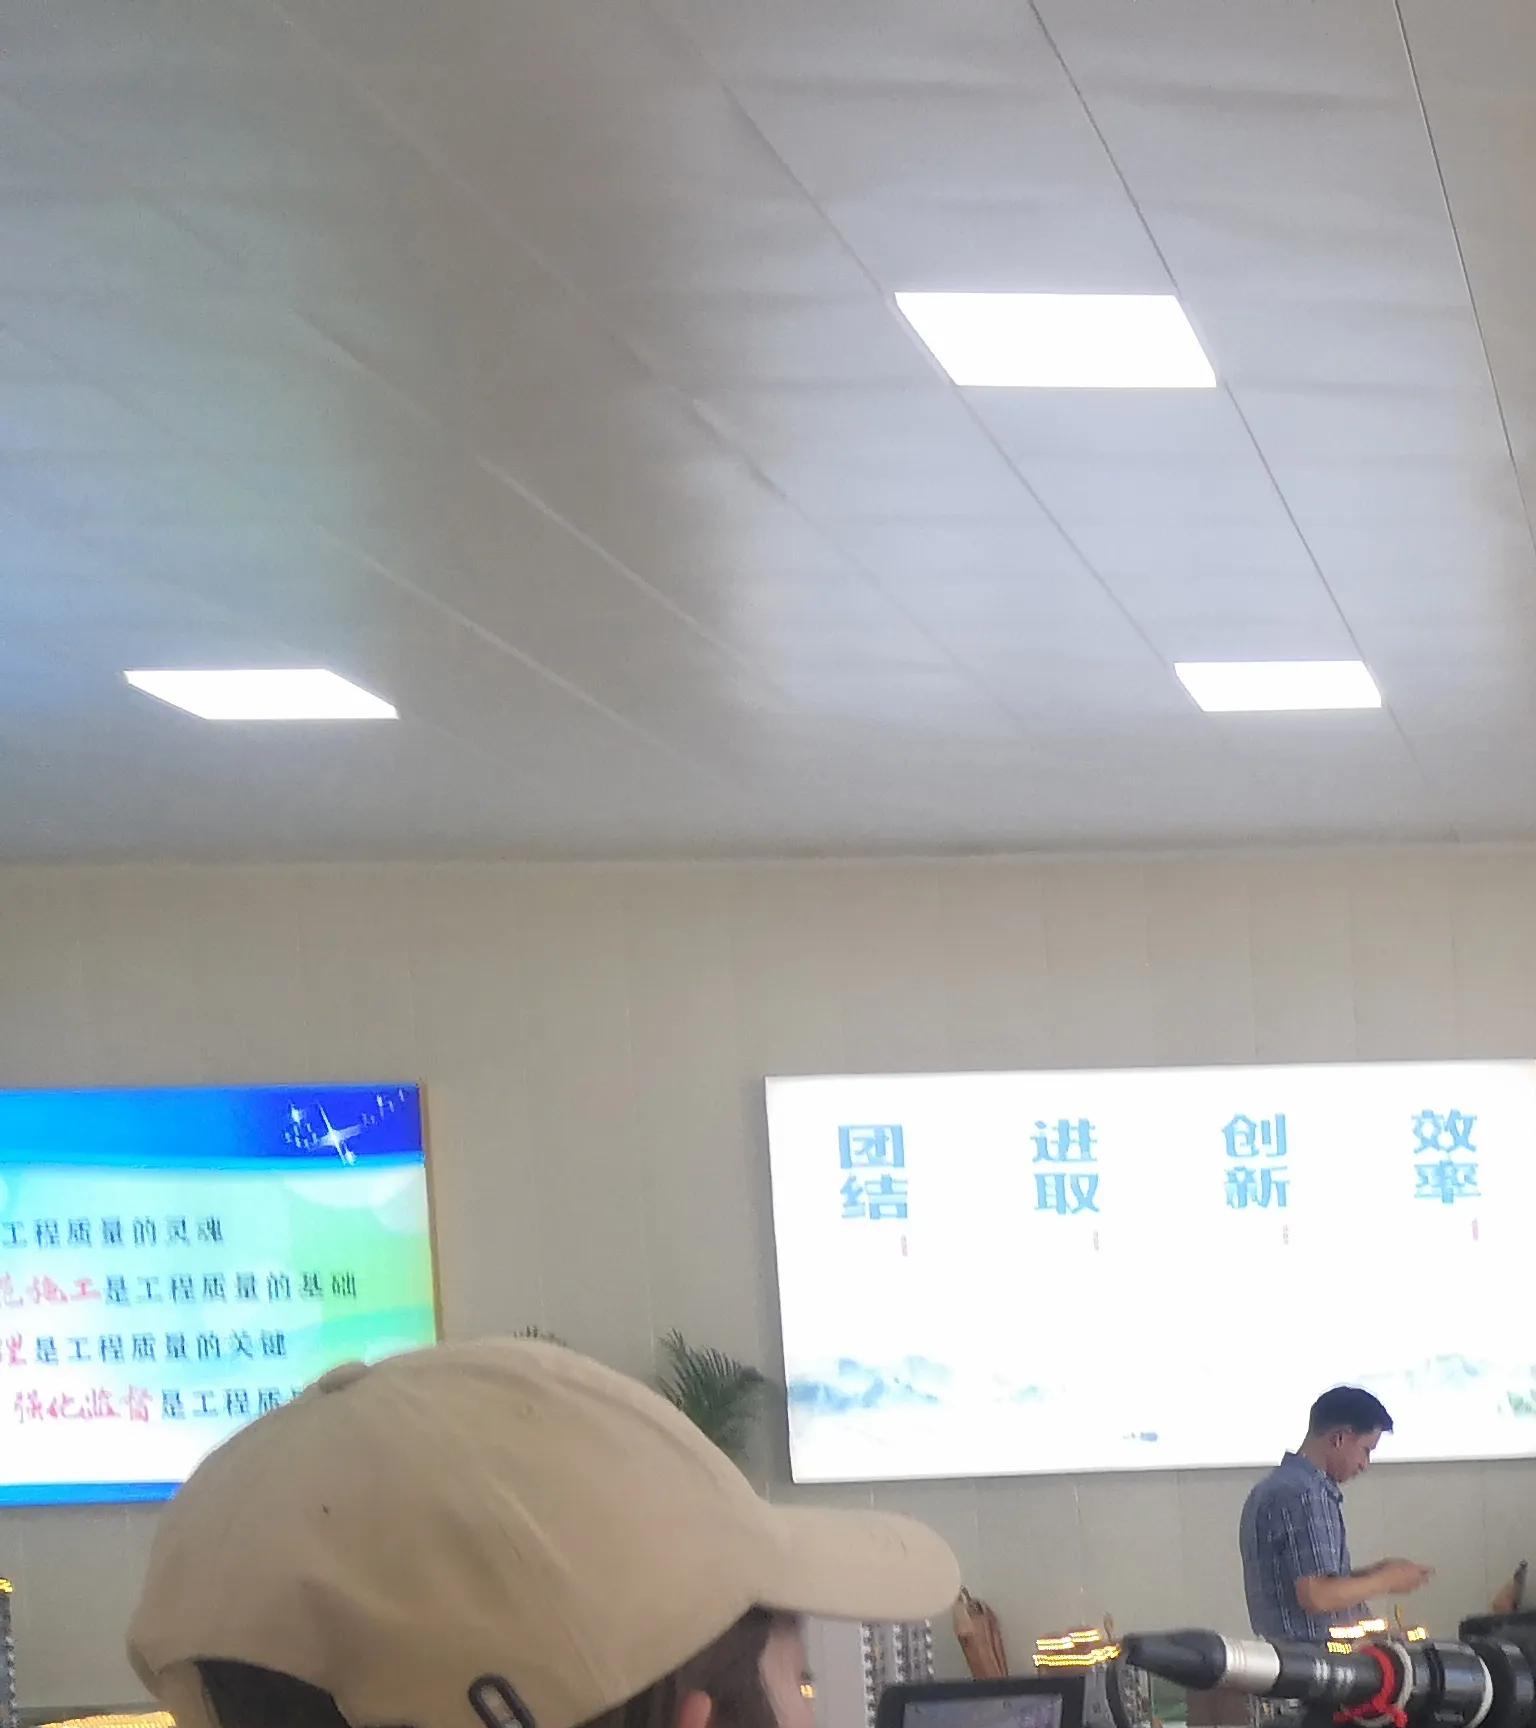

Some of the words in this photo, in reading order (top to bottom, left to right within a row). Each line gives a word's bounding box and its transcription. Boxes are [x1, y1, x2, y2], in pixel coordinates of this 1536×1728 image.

[837, 1123, 909, 1221] 团结
[1029, 1117, 1101, 1216] 进取
[1221, 1112, 1291, 1210] 创新
[1411, 1108, 1482, 1205] 效率
